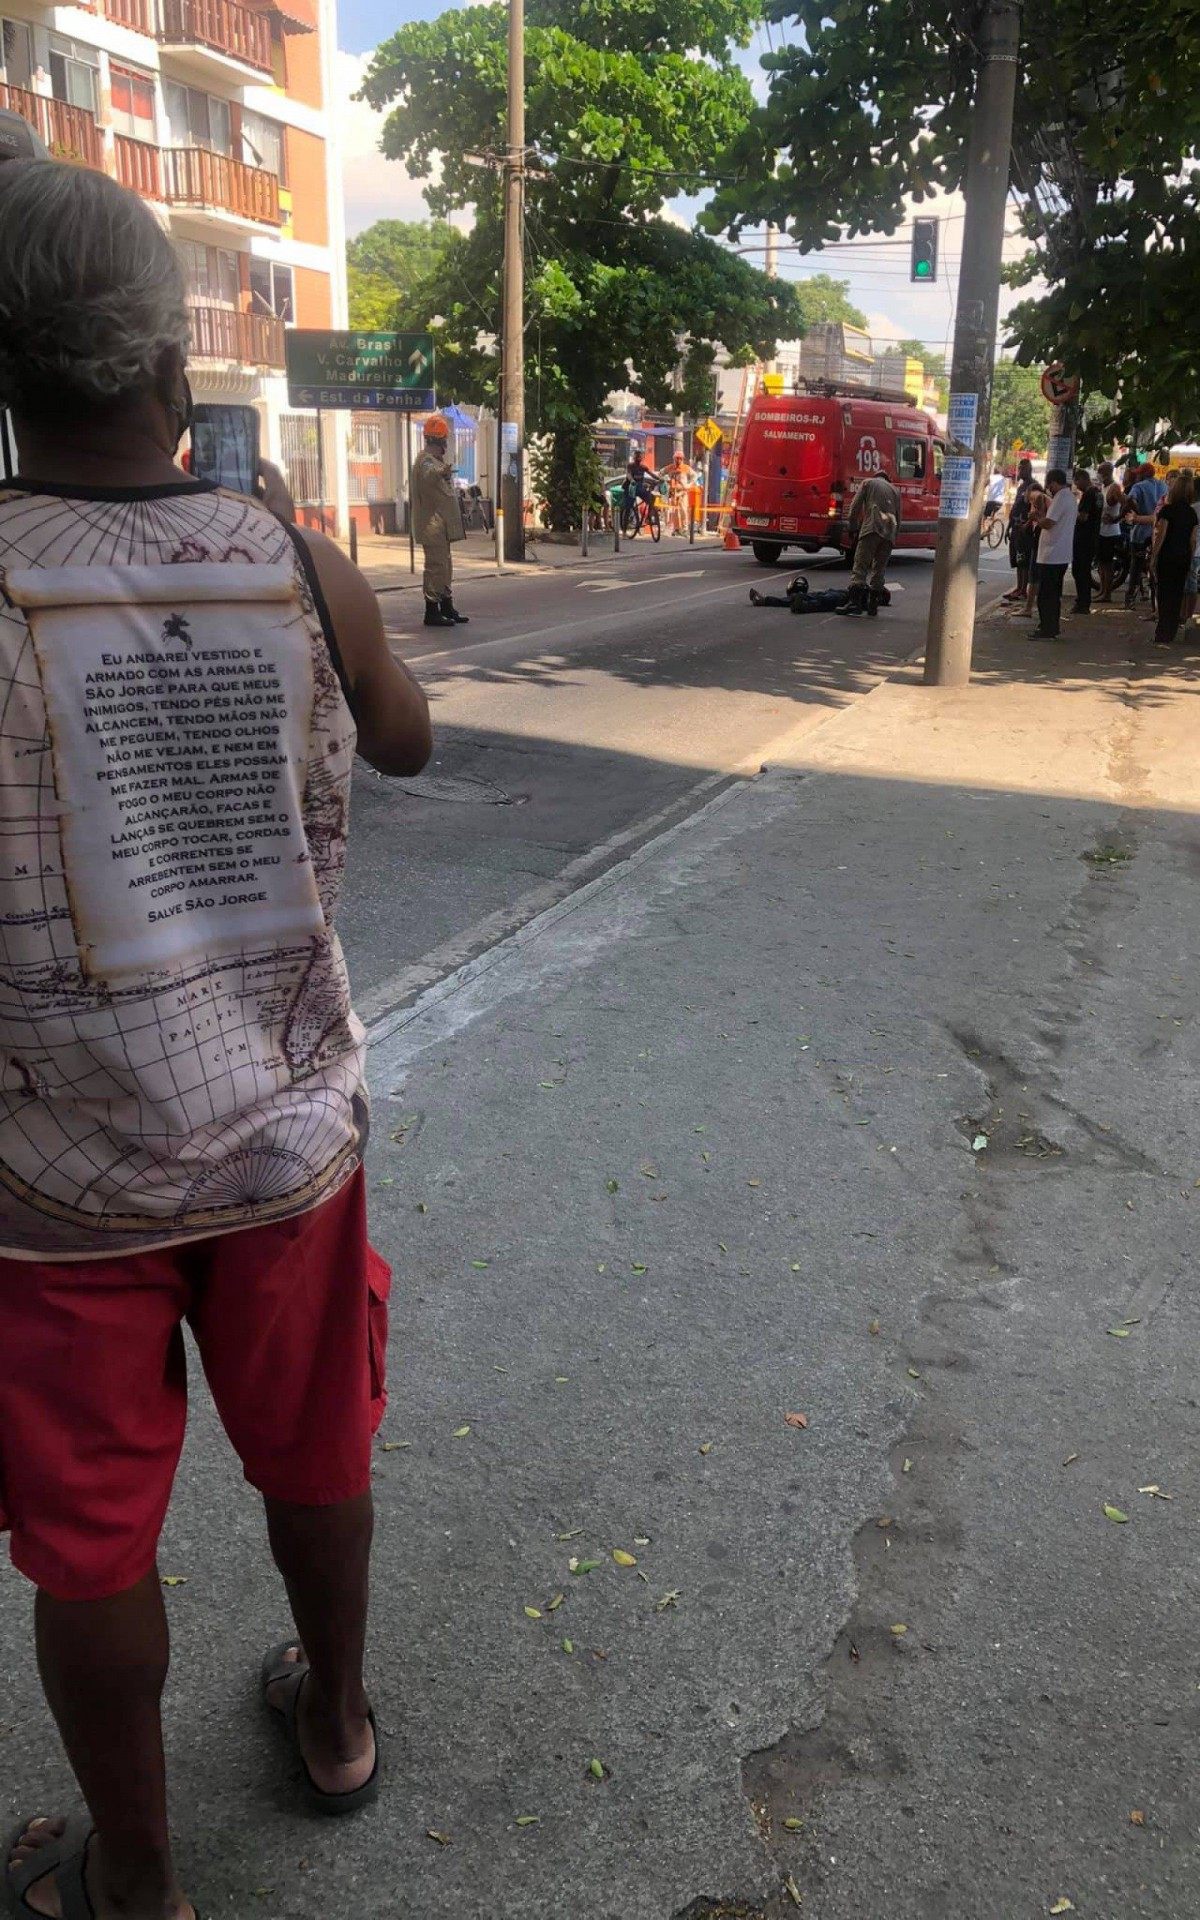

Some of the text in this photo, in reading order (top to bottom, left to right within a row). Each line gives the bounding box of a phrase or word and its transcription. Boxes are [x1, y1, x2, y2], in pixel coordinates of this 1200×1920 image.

[329, 338, 402, 350] Av. Brasil
[316, 353, 403, 366] V. Carvalho
[326, 370, 403, 382] Madureira
[319, 391, 422, 405] Est. da Penha
[754, 412, 826, 424] BOMBEIROS-RJ
[763, 430, 816, 441] SALVAMENTO
[856, 449, 880, 472] 193
[101, 649, 262, 665] EU ANDAREI VESTIDO E
[85, 663, 276, 684] ARMADO COM AS ARMAS DE
[85, 678, 280, 700] SÃO JORGE PARA QUE MEUS
[83, 694, 286, 717] INIMIGOS, TENDO PÉS NÃO ME
[85, 709, 287, 734] ALCANCEM, TENDO MÃOS NÃO
[100, 725, 280, 749] ME PEGUEM, TENDO OLHOS
[107, 741, 278, 765] NÃO ME VEJAM, E NEM EM
[96, 755, 288, 782] PENSAMENTOS ELES POSSAM
[110, 770, 281, 796] ME FAZER MAL. ARMAS DE
[118, 784, 276, 811] FOGO O MEU CORPO NÃO
[125, 800, 272, 826] ALCANÇARÃO, FACAS E
[110, 813, 289, 844] LANÇAS SE QUEBREM SEM O
[111, 828, 291, 860] MEU CORPO TOCAR, CORDAS
[149, 845, 253, 867] E CORRENTES SE
[128, 856, 281, 889] ARREBENTEM SEM O MEU
[150, 873, 258, 899] CORPO AMARRAR.
[147, 891, 267, 923] SALVE SÃO JORGE
